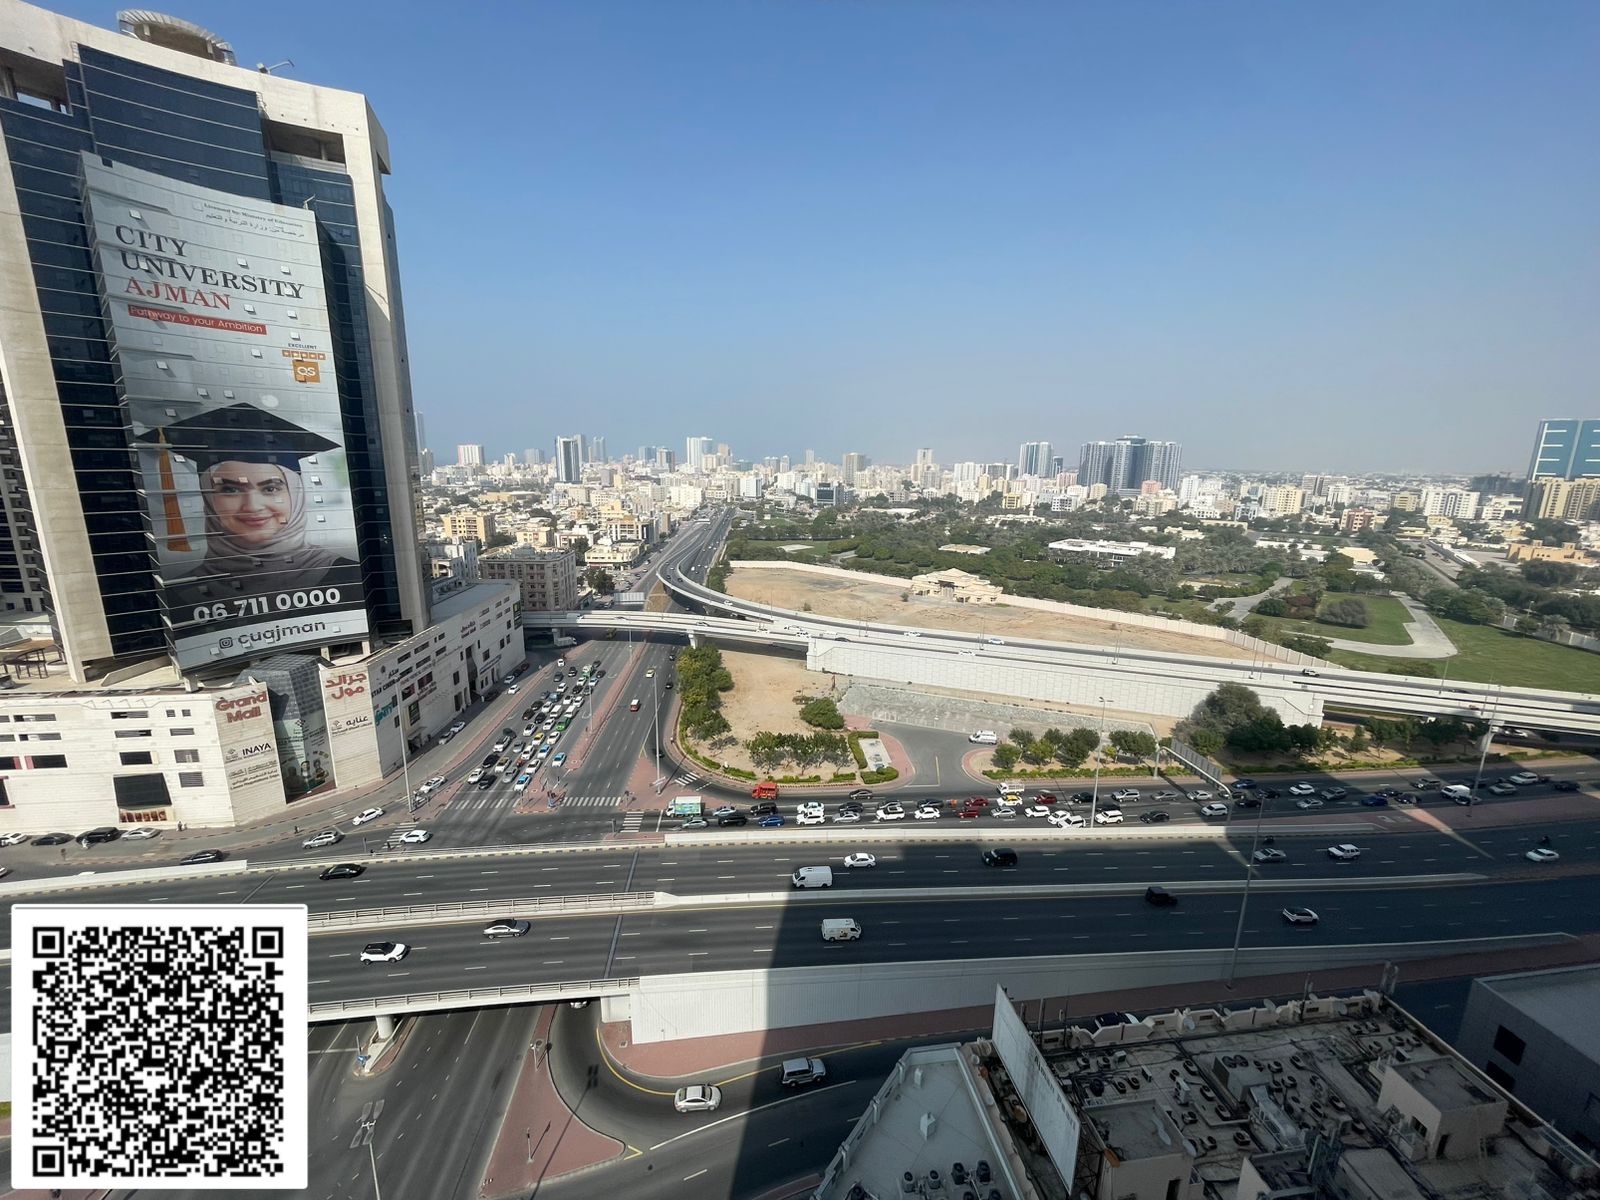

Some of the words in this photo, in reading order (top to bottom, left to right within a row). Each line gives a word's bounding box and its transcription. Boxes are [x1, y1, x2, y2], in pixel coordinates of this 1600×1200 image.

[115, 224, 189, 257] CITY
[120, 249, 305, 300] UNIVERSITY
[124, 275, 231, 311] AJMAN
[130, 305, 176, 322] Pathway
[178, 314, 190, 323] to
[192, 316, 215, 327] your
[217, 320, 263, 333] Ambition
[288, 342, 317, 350] EXCELLENT
[297, 366, 316, 377] QS
[193, 602, 228, 623] 06
[233, 596, 269, 618] 711
[275, 587, 341, 610] 0000
[237, 619, 326, 644] cuajman
[216, 691, 268, 712] Grand
[331, 685, 365, 700] مول
[226, 706, 262, 723] Mall
[242, 742, 272, 756] INAYA
